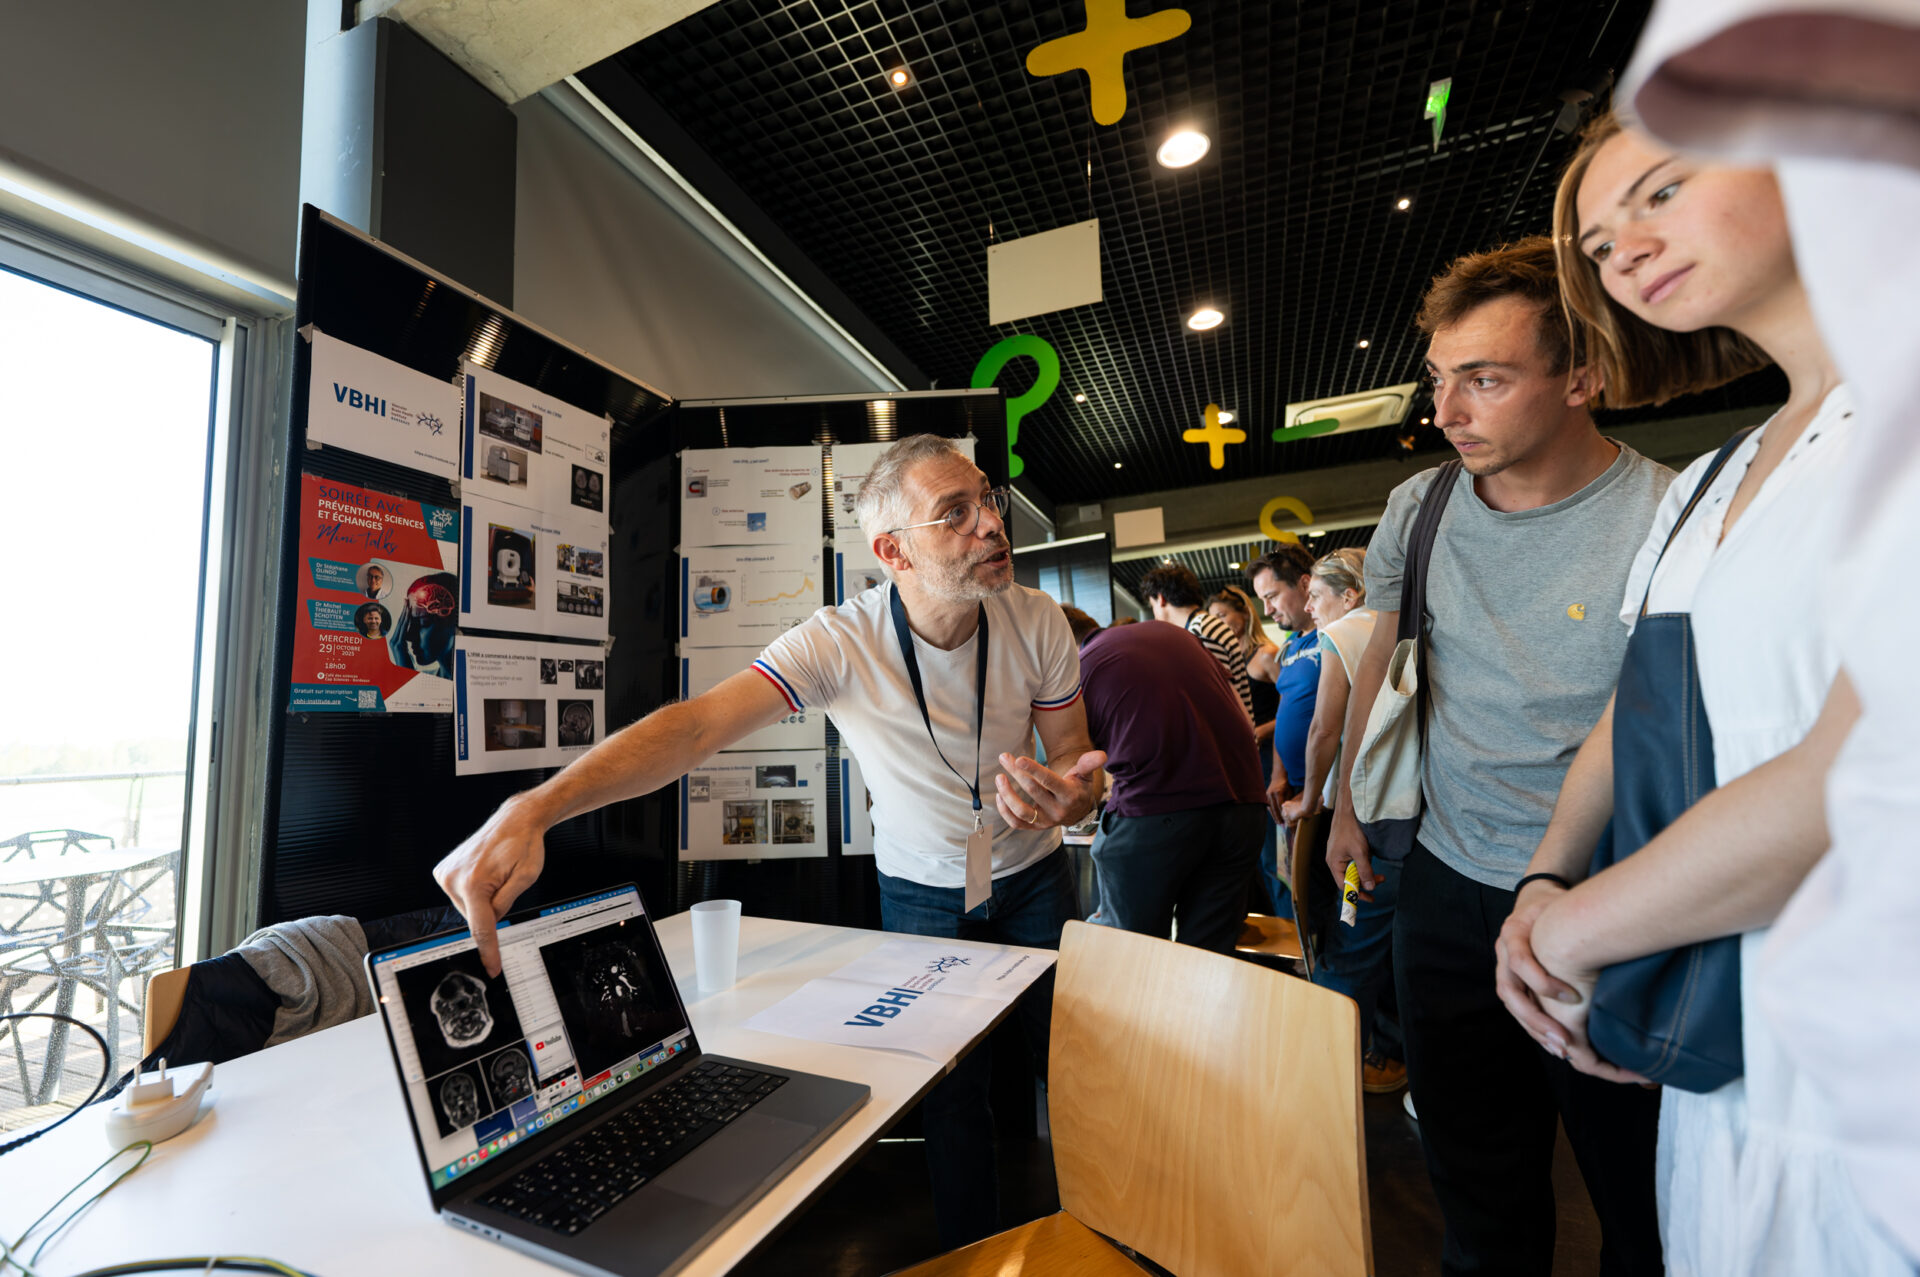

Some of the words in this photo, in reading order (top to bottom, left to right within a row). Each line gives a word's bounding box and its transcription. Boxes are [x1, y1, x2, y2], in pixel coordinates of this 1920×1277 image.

[333, 382, 386, 417] VBHI
[319, 486, 372, 508] SOIRÉE
[376, 502, 404, 515] AVC
[318, 499, 383, 522] PRÉVENTION,
[384, 514, 424, 530] SCIENCES
[318, 510, 330, 520] ET
[332, 511, 383, 531] ÉCHANGES
[429, 519, 444, 528] VBHI
[316, 522, 356, 545] Mini
[357, 528, 398, 555] Talks
[319, 634, 363, 645] MERCREDI
[319, 643, 332, 653] 29
[325, 662, 346, 670] 18h00
[844, 987, 925, 1027] VBHI
